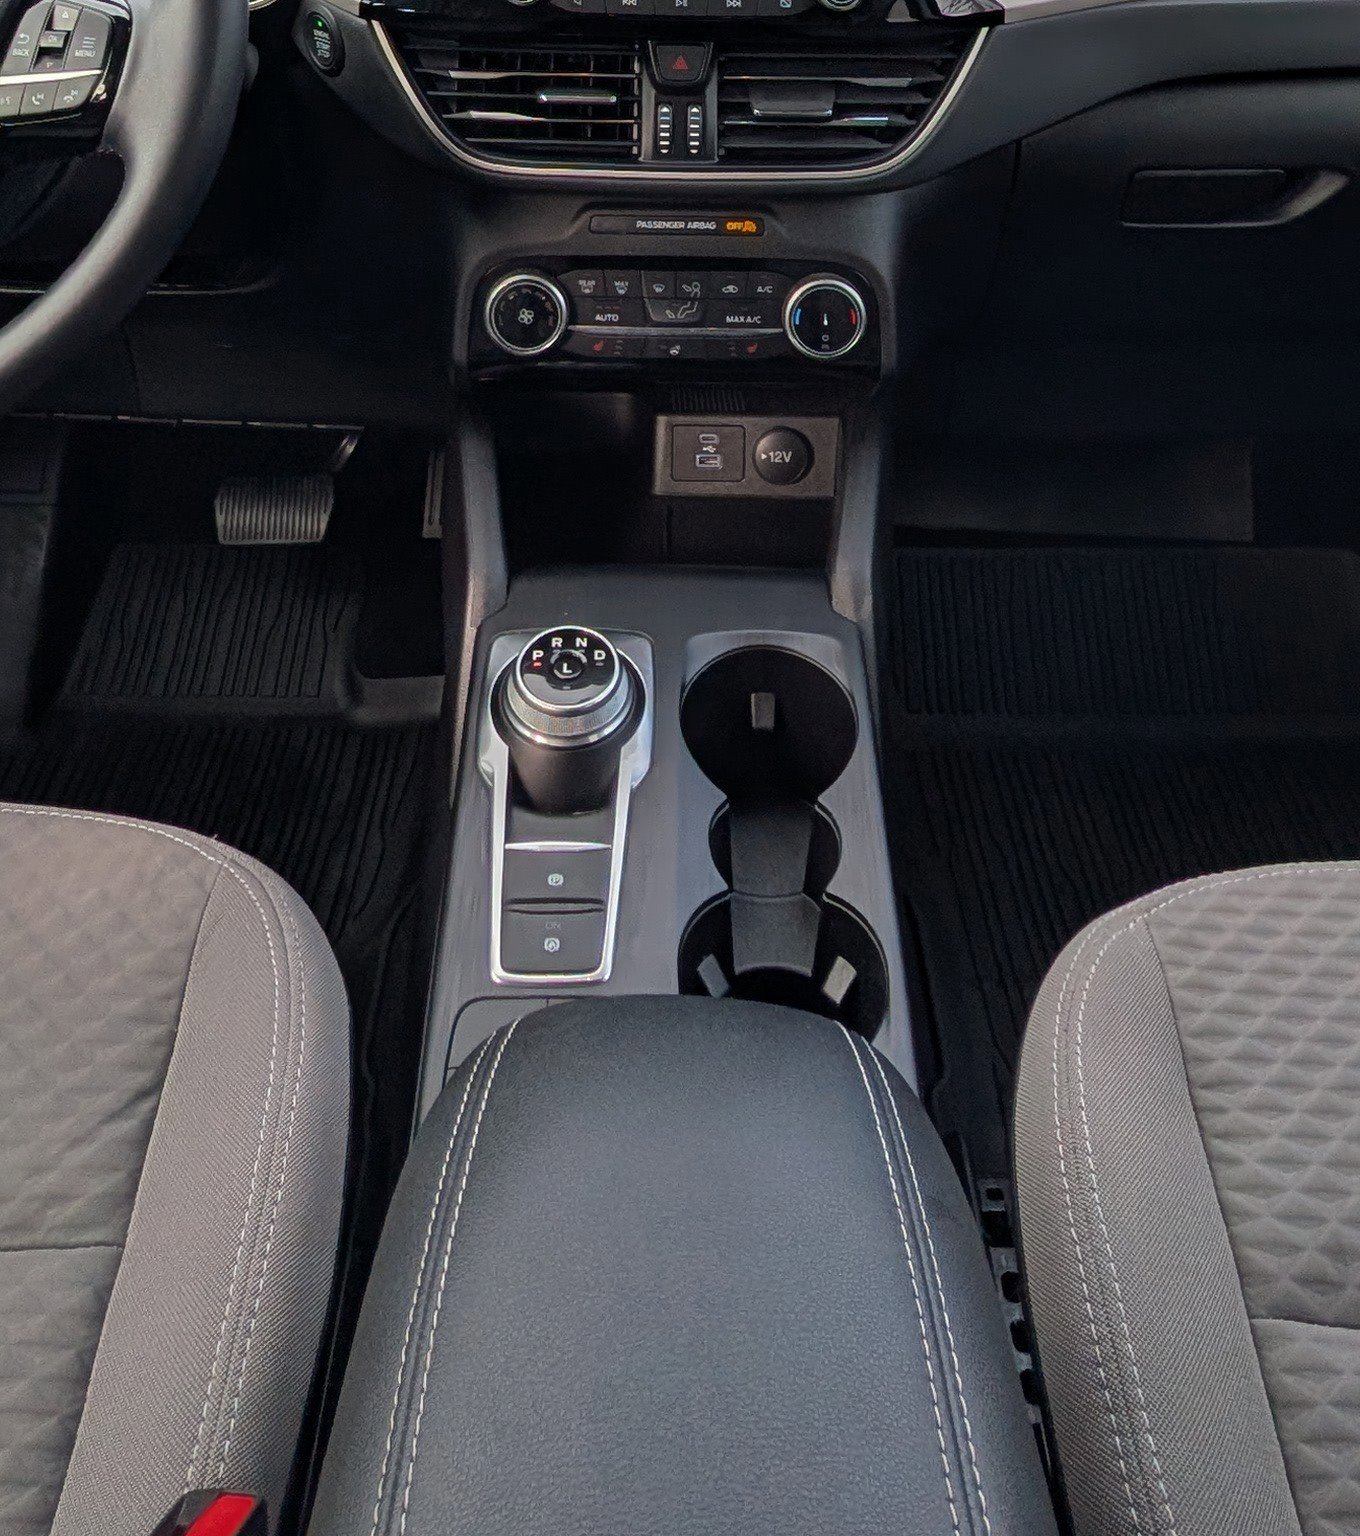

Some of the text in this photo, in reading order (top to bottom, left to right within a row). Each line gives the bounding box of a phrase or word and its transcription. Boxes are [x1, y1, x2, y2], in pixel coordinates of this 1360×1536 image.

[12, 48, 30, 57] BACK
[74, 49, 96, 58] MENU
[636, 220, 743, 231] PASSENGER AIRBAG OFF
[756, 286, 773, 294] A/C
[595, 313, 619, 322] AUTO
[726, 316, 762, 324] MAX A/C
[769, 450, 792, 463] 12V
[551, 637, 588, 648] R N
[532, 650, 606, 661] P D
[562, 663, 573, 674] L
